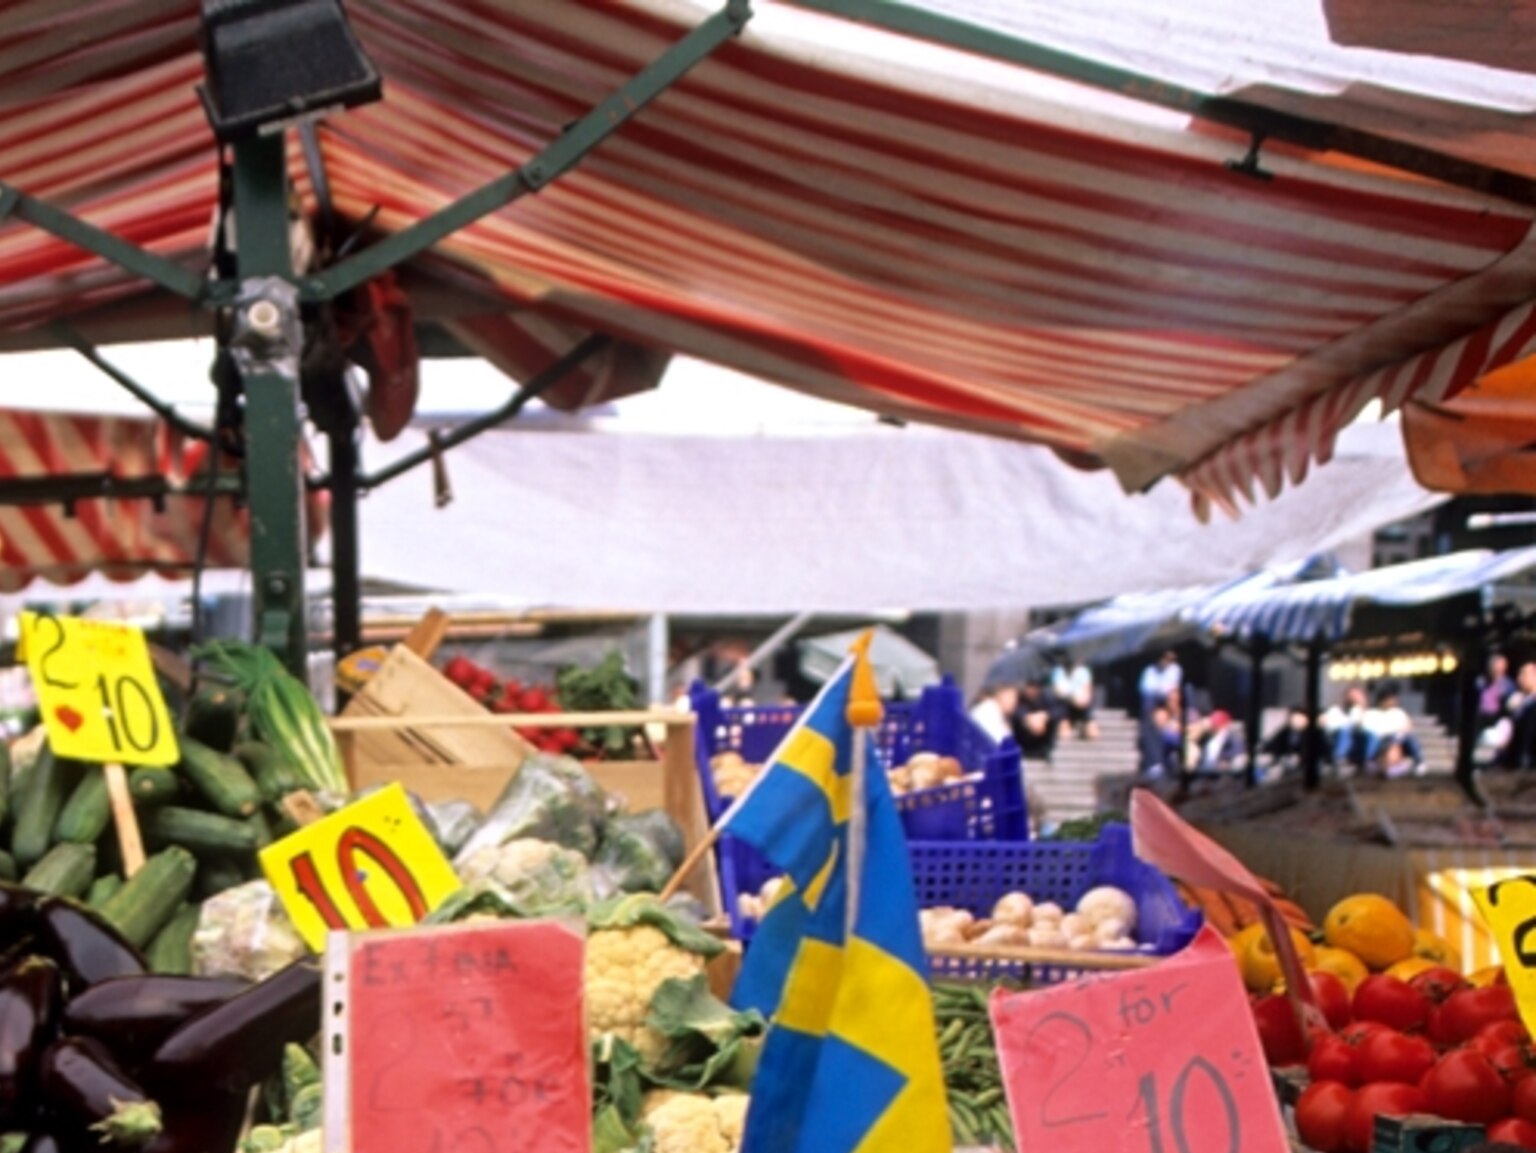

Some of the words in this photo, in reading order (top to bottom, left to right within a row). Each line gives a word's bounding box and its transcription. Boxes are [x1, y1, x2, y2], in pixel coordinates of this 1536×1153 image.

[33, 612, 79, 690] 2
[94, 672, 159, 753] 10
[288, 825, 429, 931] 10
[1023, 1010, 1109, 1128] 2
